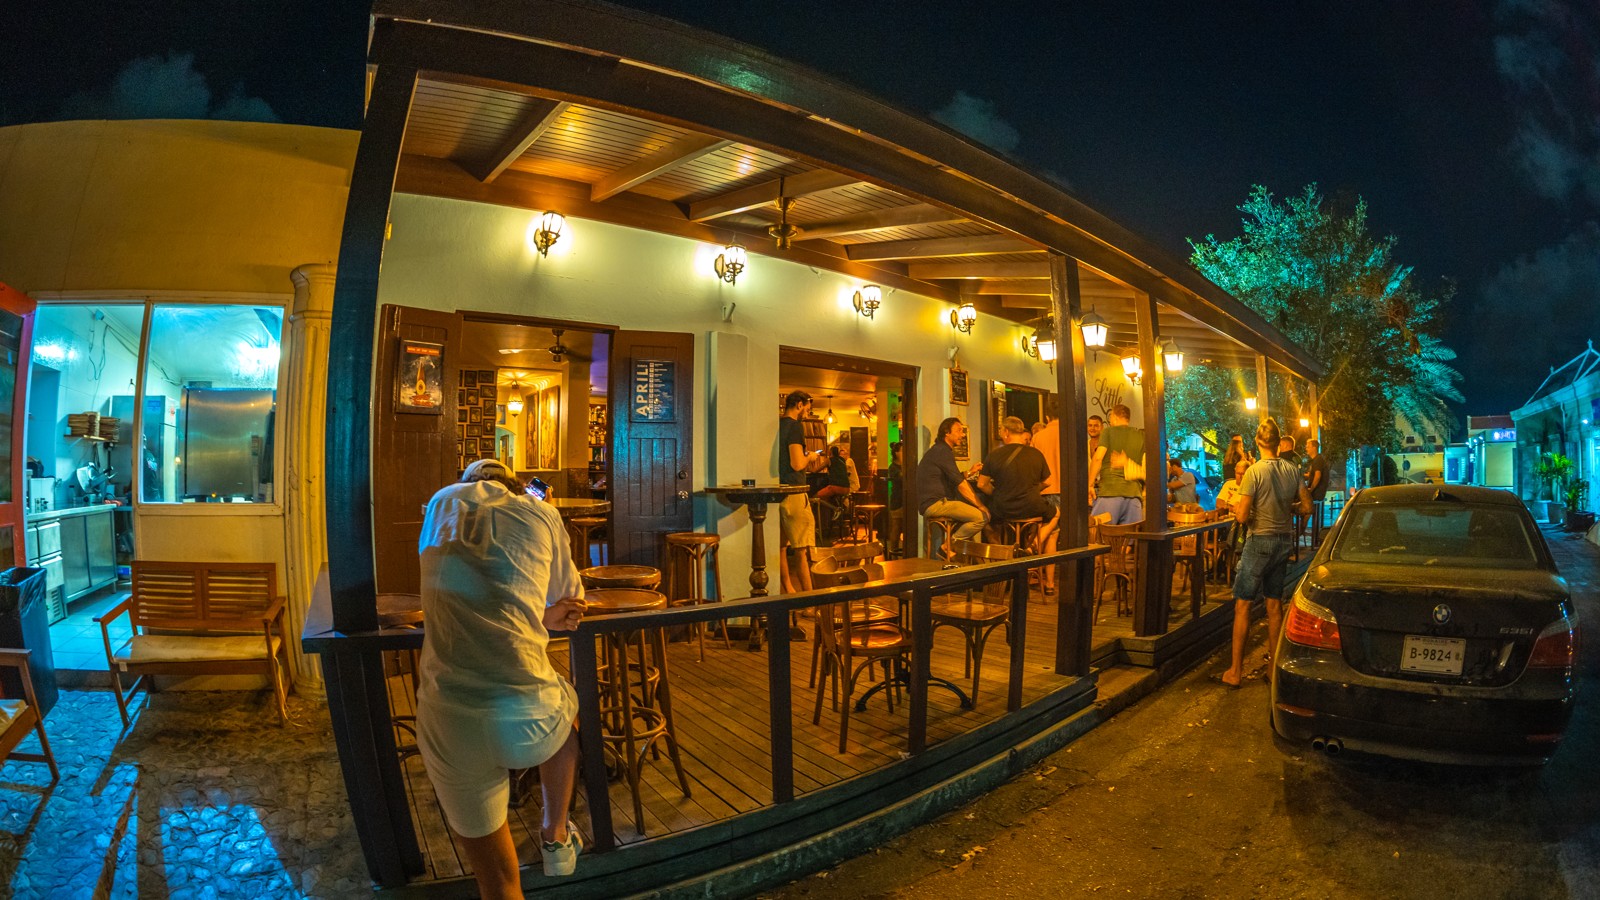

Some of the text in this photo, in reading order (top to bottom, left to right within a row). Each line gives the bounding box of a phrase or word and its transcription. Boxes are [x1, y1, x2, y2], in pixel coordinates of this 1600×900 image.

[636, 368, 649, 417] APRIL
[1091, 377, 1124, 411] Little
[1410, 647, 1452, 661] B-9824
